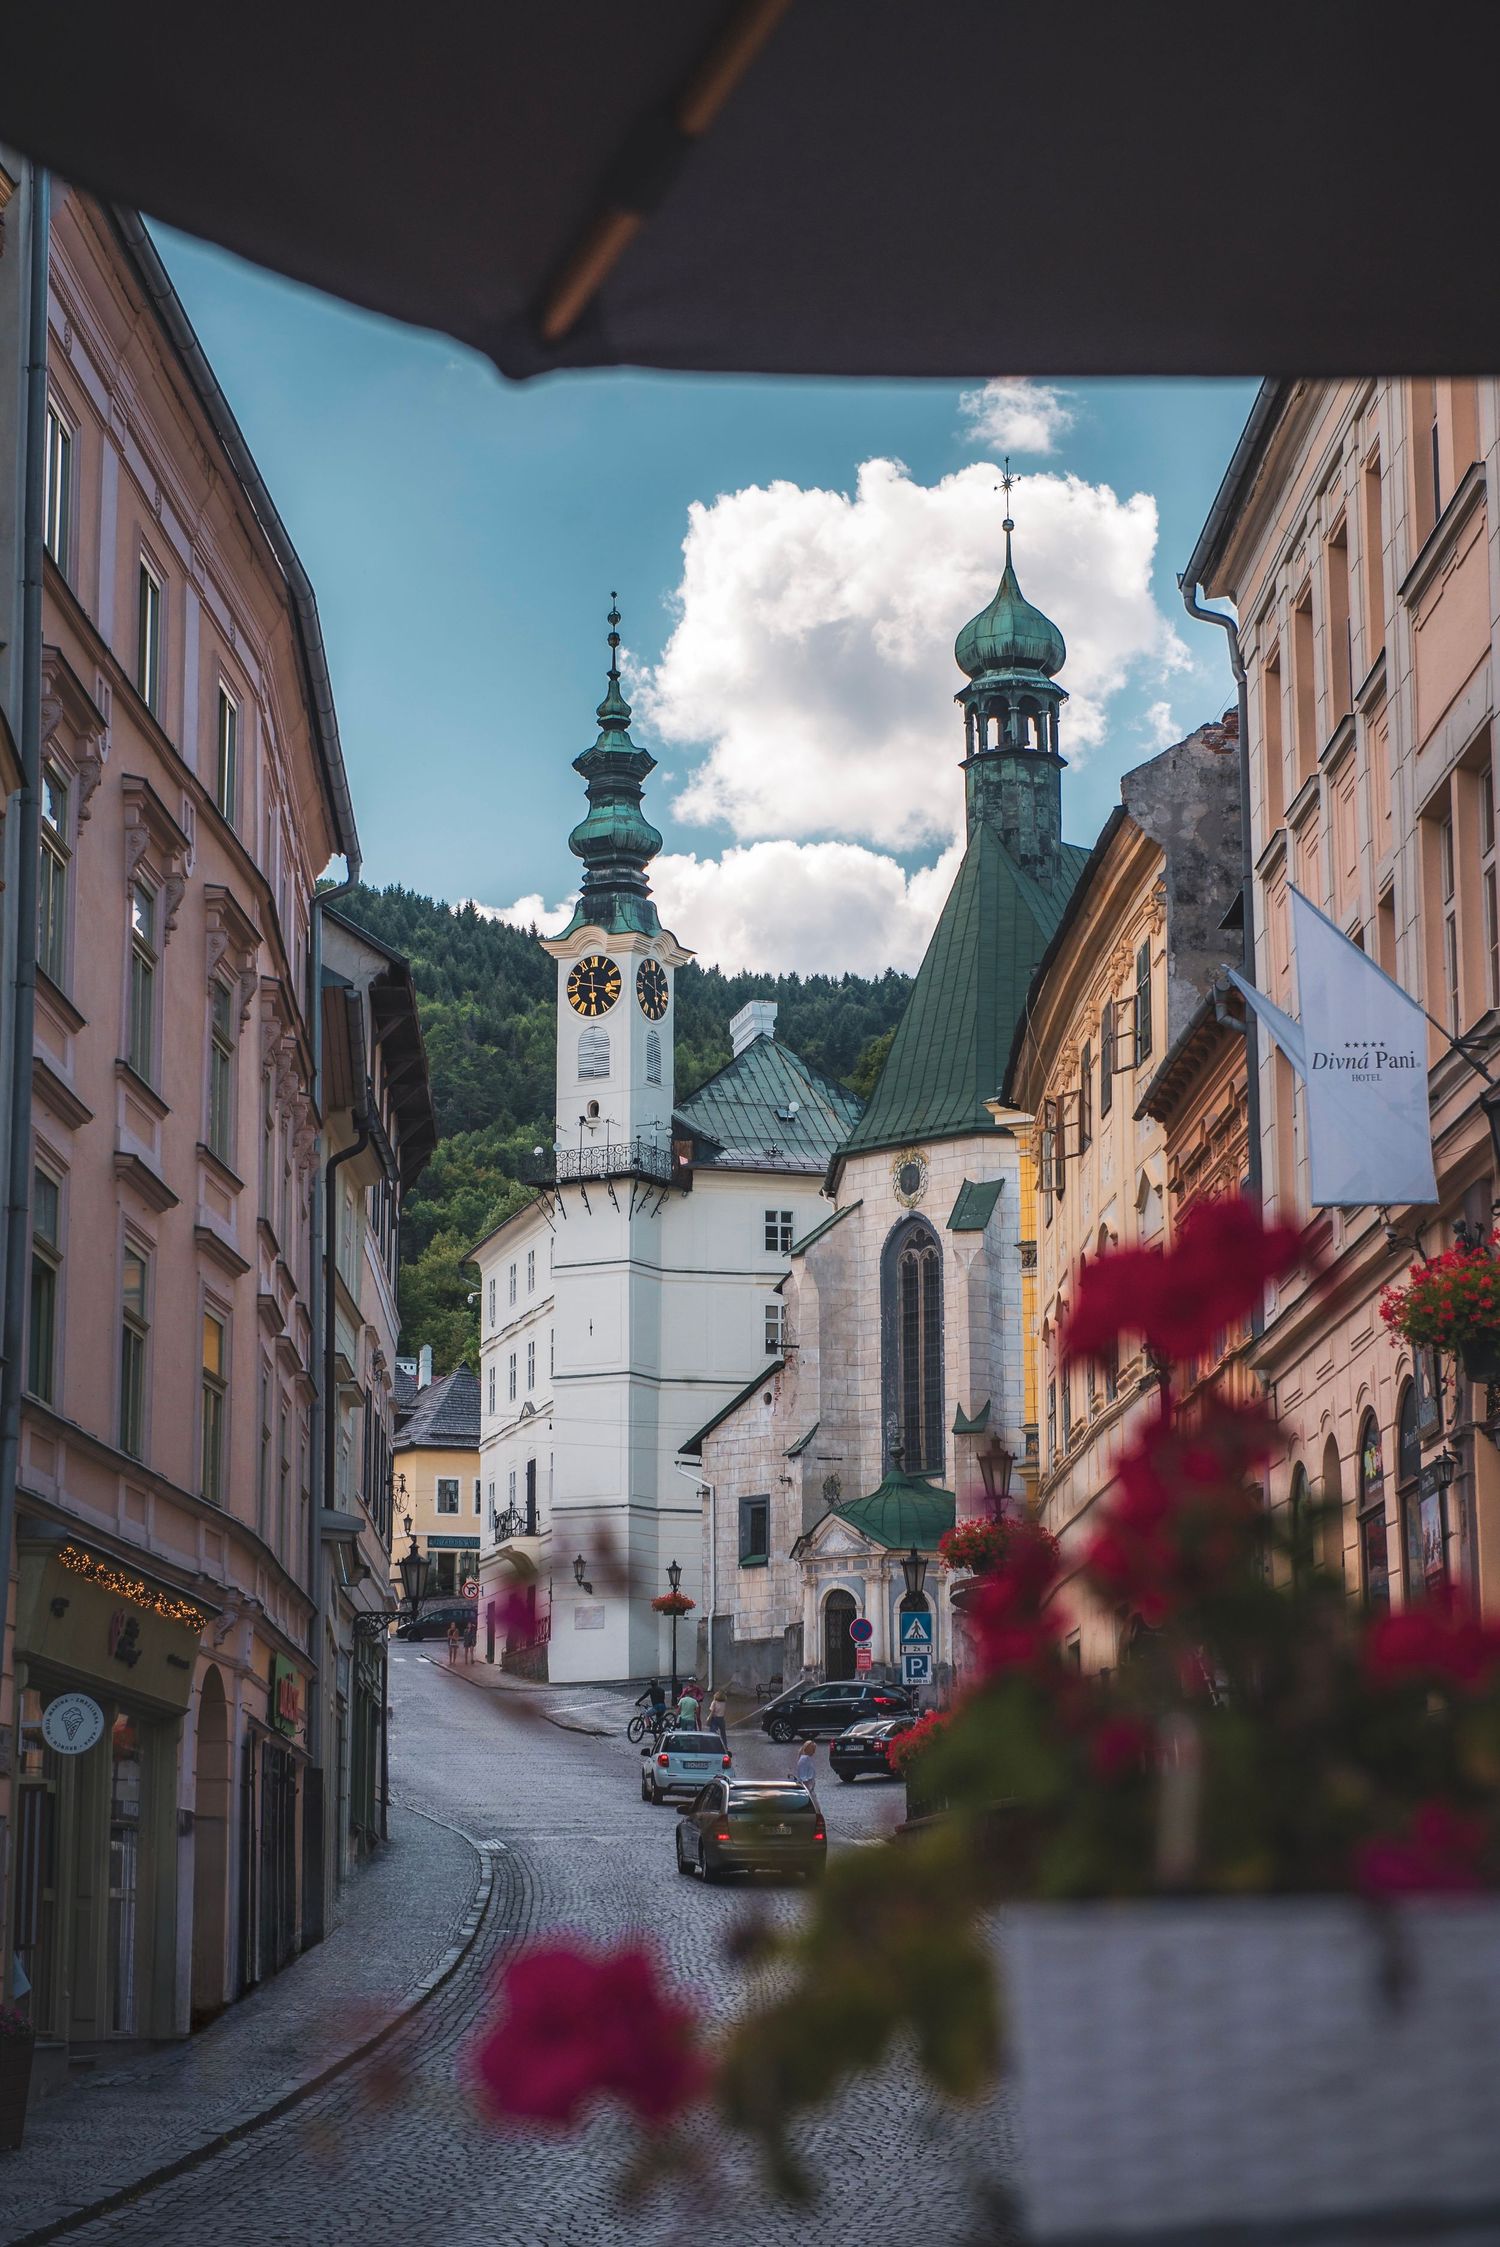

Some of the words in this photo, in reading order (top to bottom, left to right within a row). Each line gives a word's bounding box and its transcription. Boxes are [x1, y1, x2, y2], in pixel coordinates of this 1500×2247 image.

[1312, 1052, 1368, 1070] Divná
[1375, 1050, 1416, 1069] Pani
[1352, 1073, 1382, 1082] HOTEL
[911, 1658, 923, 1676] P
